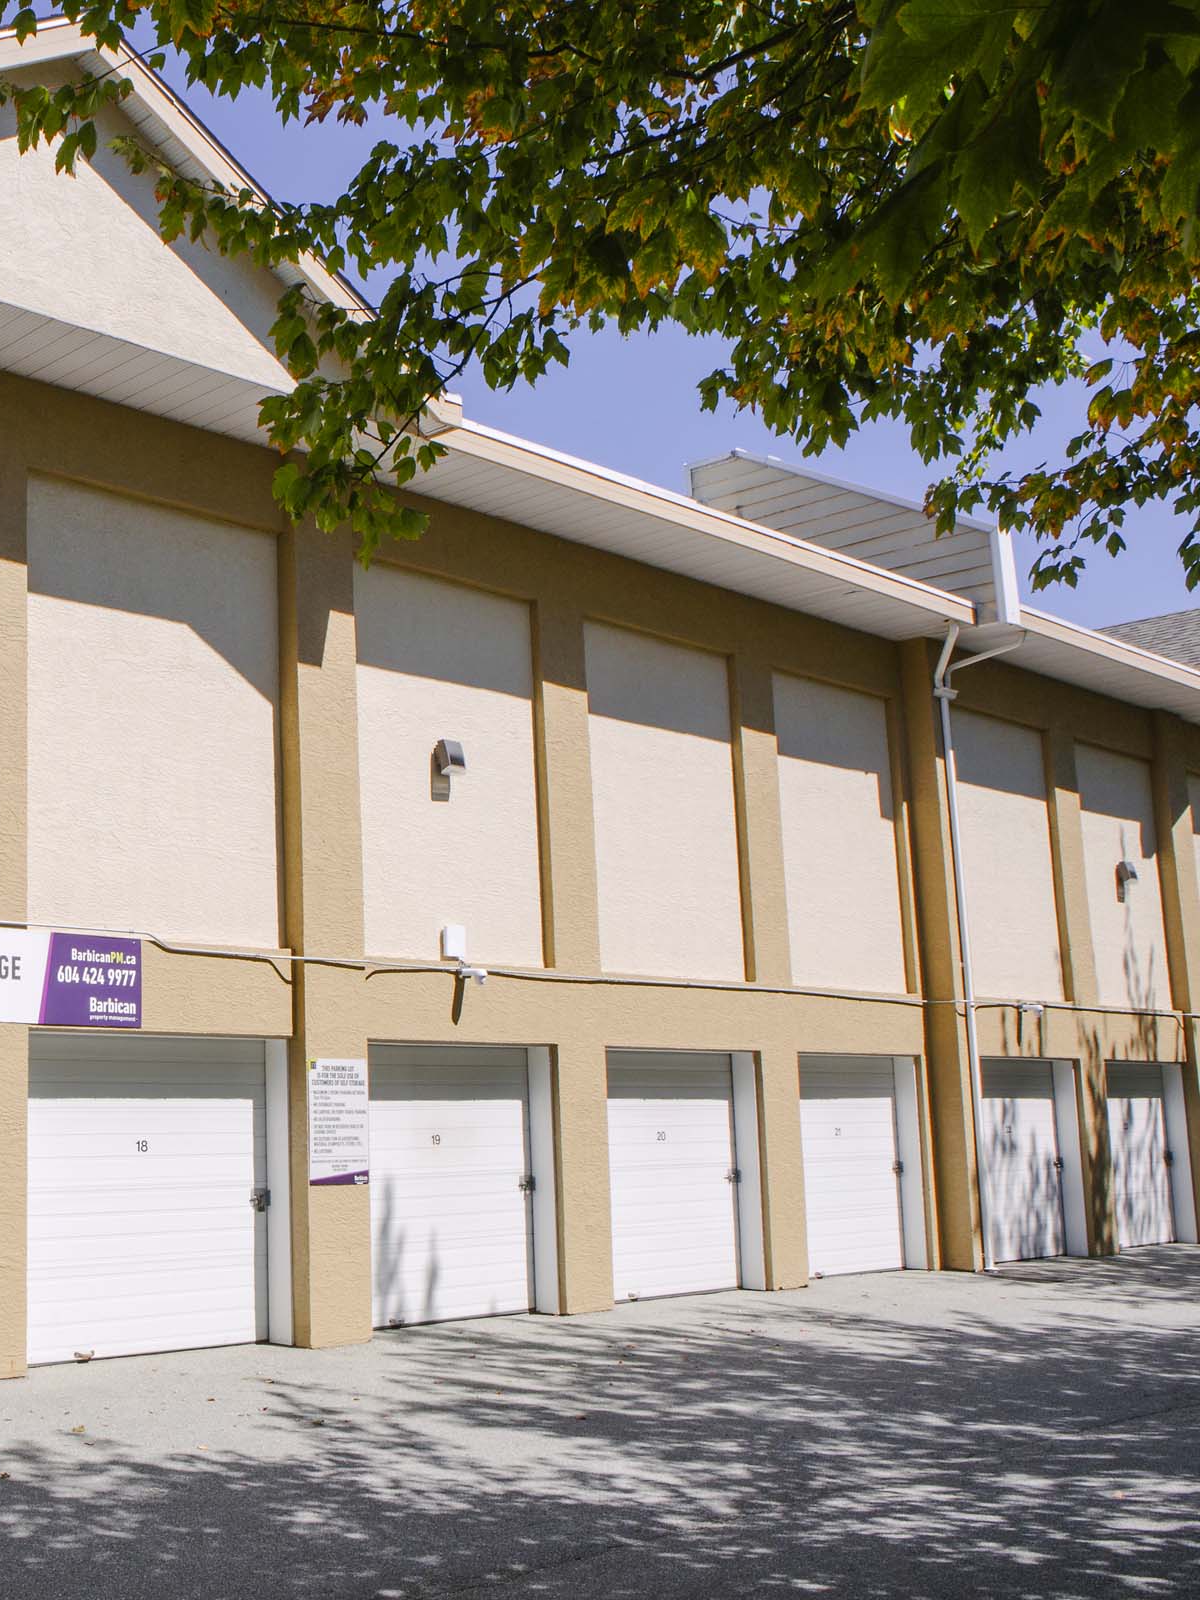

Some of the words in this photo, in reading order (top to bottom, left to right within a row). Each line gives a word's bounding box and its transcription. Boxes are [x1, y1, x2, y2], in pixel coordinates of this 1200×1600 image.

[71, 948, 136, 965] BarbicanPM.ca
[57, 965, 80, 983] 604
[82, 966, 105, 985] 424
[107, 968, 136, 987] 9977
[89, 997, 136, 1015] Barbican
[656, 1131, 666, 1141] 20
[835, 1127, 841, 1136] 21
[136, 1139, 149, 1153] 18
[431, 1134, 441, 1145] 19
